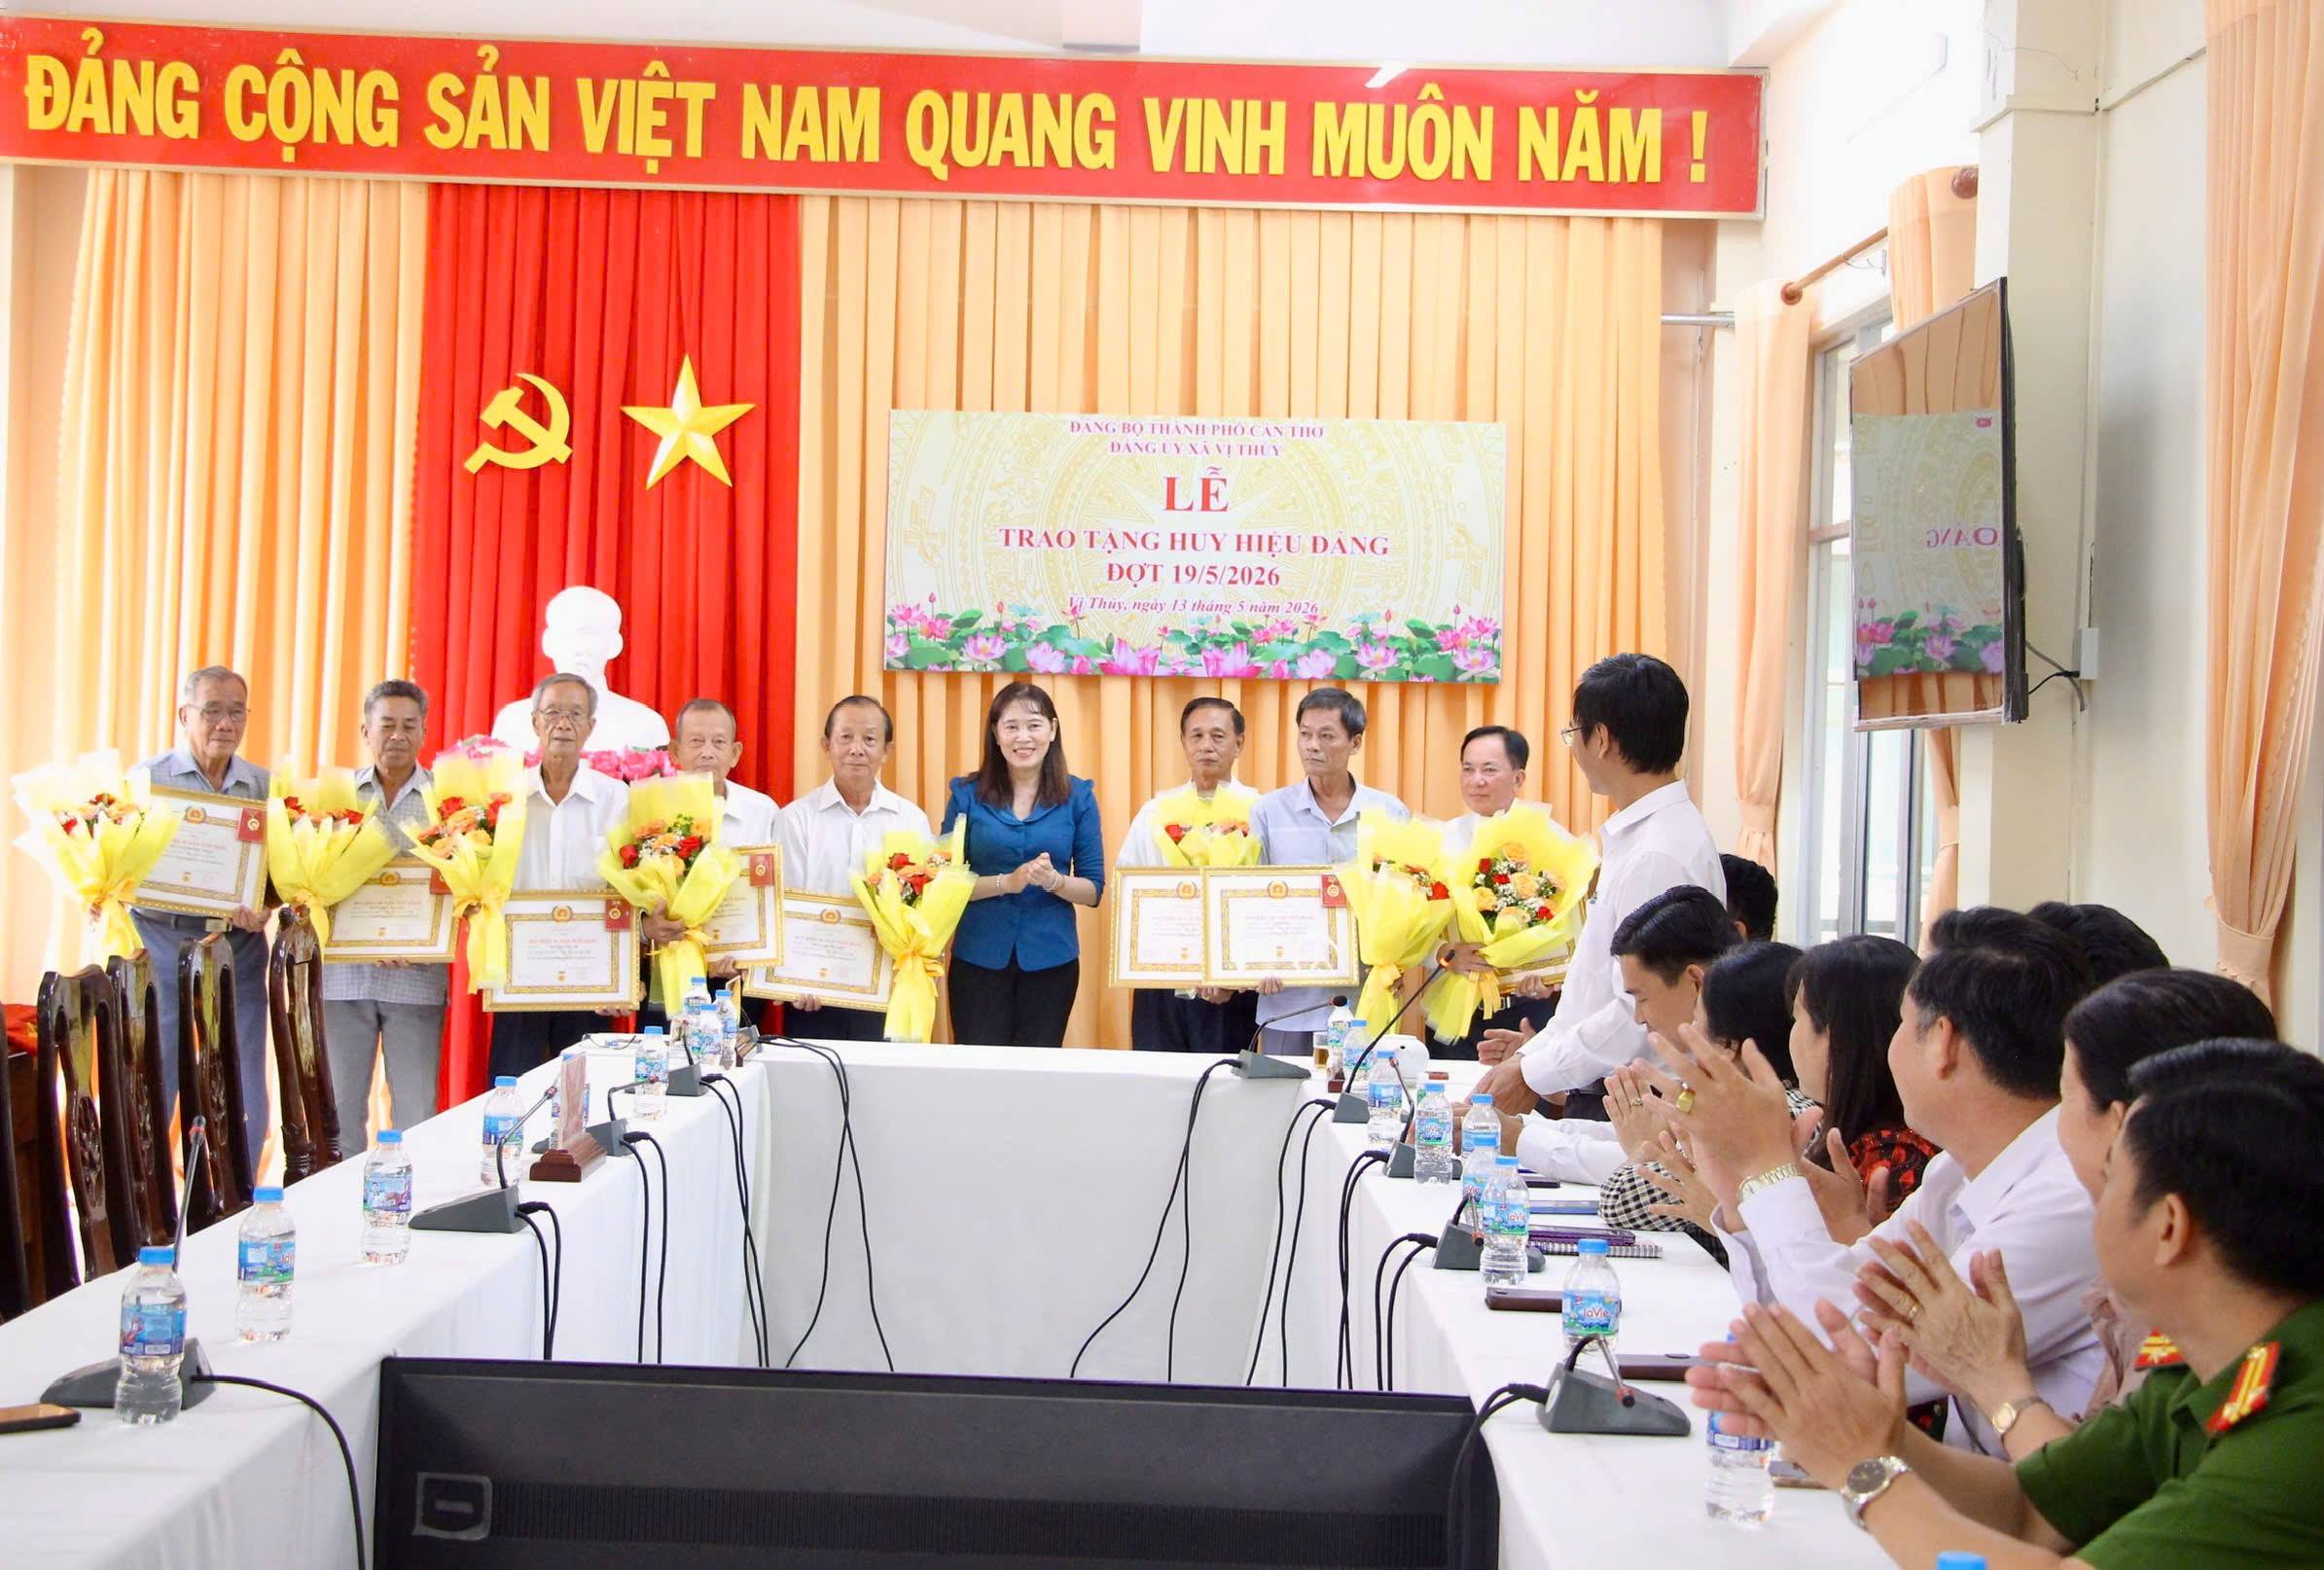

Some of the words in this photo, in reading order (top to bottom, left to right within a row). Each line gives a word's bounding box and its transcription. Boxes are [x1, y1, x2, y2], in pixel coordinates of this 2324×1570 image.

[24, 27, 199, 139] ĐẢNG
[224, 49, 399, 162] CỘNG
[424, 45, 551, 152] SẢN
[577, 60, 717, 175] VIỆT
[741, 84, 881, 162] NAM
[906, 89, 1117, 182] QUANG
[1144, 96, 1287, 175] VINH
[1312, 82, 1494, 182] MUÔN
[1519, 89, 1663, 184] NĂM
[1690, 110, 1708, 183] !
[1162, 466, 1230, 513] LỄ
[999, 527, 1076, 550] TRAO
[1169, 532, 1231, 553] HUY
[1235, 531, 1304, 558] HIỆU
[1310, 531, 1389, 555] ĐẢNG
[1106, 562, 1164, 589] ĐỢT
[1173, 564, 1280, 587] 19/5/2026
[1132, 597, 1166, 613] ngày
[1172, 599, 1187, 612] 13
[1191, 598, 1233, 615] tháng
[1236, 600, 1245, 612] 5
[1285, 601, 1320, 615] 2026
